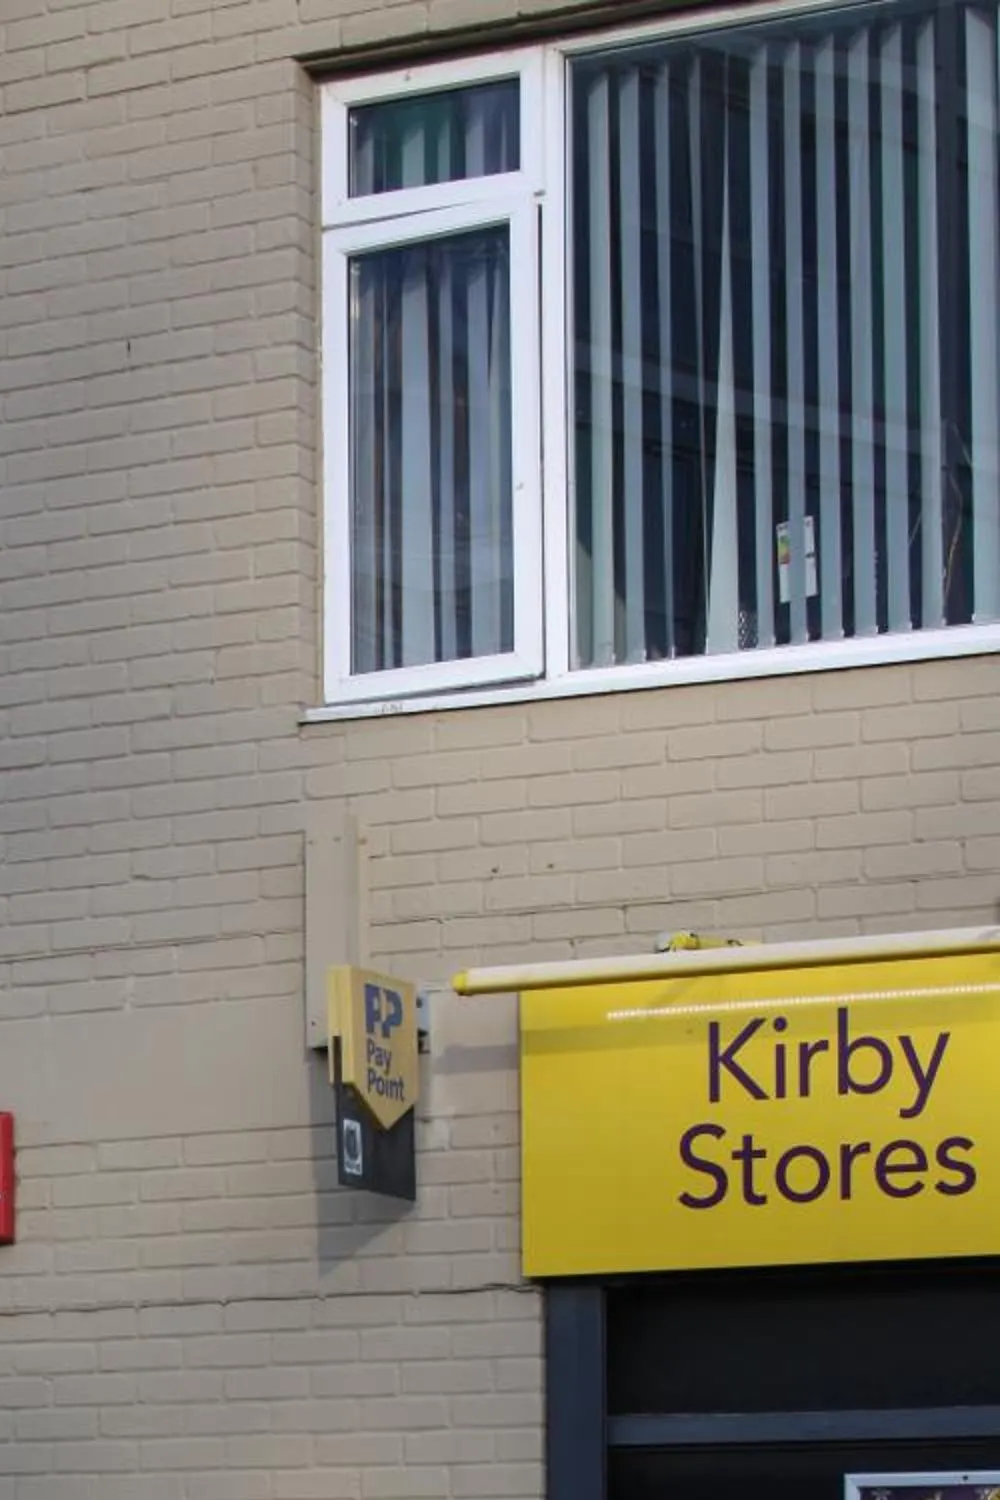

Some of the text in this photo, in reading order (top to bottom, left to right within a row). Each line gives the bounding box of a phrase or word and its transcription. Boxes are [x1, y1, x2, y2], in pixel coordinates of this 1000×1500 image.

[366, 1036, 392, 1075] Pay
[367, 1067, 405, 1102] Point
[707, 1006, 951, 1119] Kirby
[677, 1122, 978, 1210] Stores
